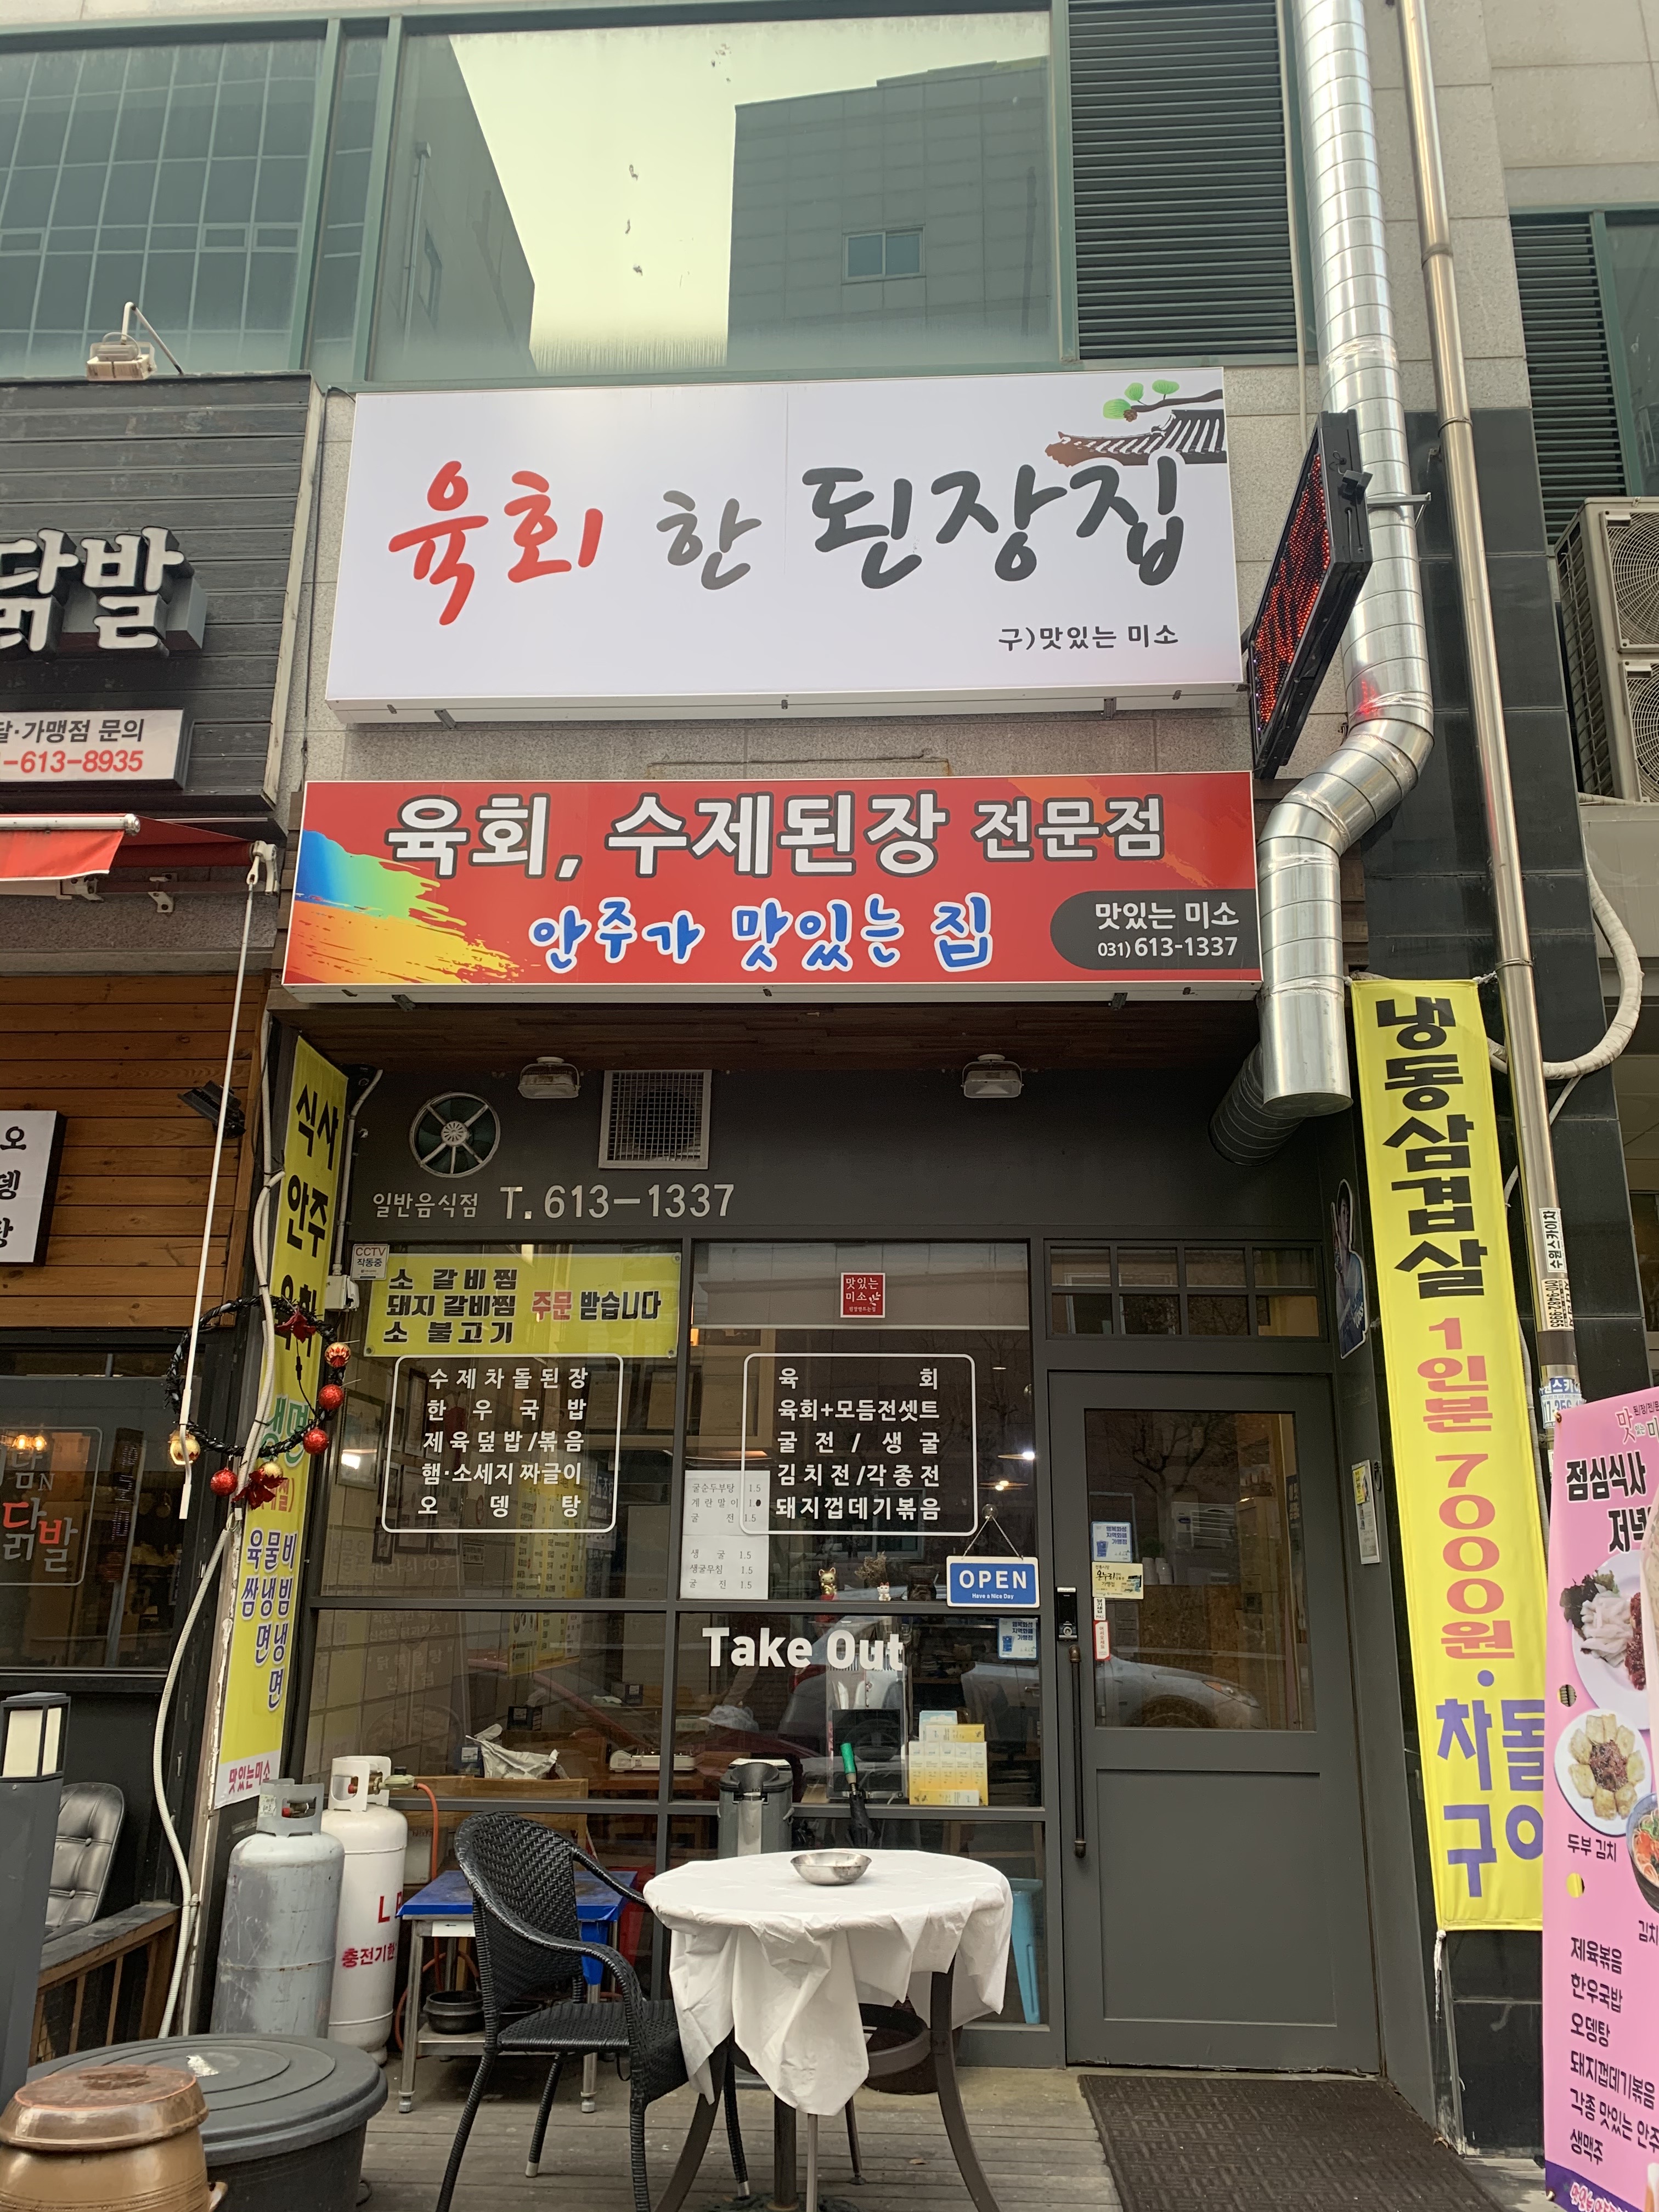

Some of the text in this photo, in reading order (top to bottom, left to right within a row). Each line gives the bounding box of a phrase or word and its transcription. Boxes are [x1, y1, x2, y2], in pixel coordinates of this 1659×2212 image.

[388, 460, 603, 626] 육회
[656, 489, 762, 591] 한
[802, 455, 1184, 590] 된장집
[998, 624, 1178, 652] 구)맛있는 미소
[99, 719, 144, 742] 문의
[385, 790, 1164, 881] 육회, 수제된장 전문점
[1094, 901, 1239, 930] 맛있는 미소
[529, 893, 992, 973] 안주가 맛있는 집
[1098, 936, 1238, 958] 031) 613-1337
[297, 1084, 338, 1170] 식사
[1375, 996, 1488, 1299] 냉동삼겹살
[287, 1175, 328, 1257] 안주
[373, 1192, 478, 1218] 일반음식점
[545, 1183, 735, 1218] 613-1337
[356, 1247, 386, 1256] CCTV
[1542, 1210, 1564, 1269] 수원스카이차
[357, 1258, 382, 1267] 작동중
[389, 1268, 518, 1291] 소 갈비찜
[845, 1277, 878, 1290] 맛있는
[386, 1294, 516, 1318] 돼지 갈비찜
[532, 1290, 662, 1321] 주문 받습니다
[845, 1291, 867, 1302] 미소
[383, 1322, 513, 1344] 소 불고기
[1417, 1317, 1493, 1433] 1인분
[777, 1399, 940, 1422] 육회+모듬전셋트
[520, 1463, 581, 1485] 짜글이
[692, 1483, 761, 1493] 굴순두부탕 1.5
[1567, 1451, 1646, 1501] 점심식사
[744, 1514, 756, 1522] 1.5
[776, 1497, 940, 1521] 돼지껍데기볶음
[3, 1497, 78, 1572] 닭발
[690, 1564, 723, 1574] 생굴무침
[1435, 1454, 1515, 1659] 7000원
[959, 1570, 1026, 1589] OPEN
[1096, 1570, 1115, 1581] 온누리
[256, 1531, 280, 1664] 물냉면
[269, 1532, 297, 1709] 비빔냉면
[702, 1627, 904, 1672] Take Out
[1435, 1699, 1545, 1791] 차돌
[1567, 1833, 1616, 1862] 두부 김치
[1639, 1920, 1658, 1946] 김치
[341, 1943, 395, 1968] 충전기한
[1571, 1937, 1622, 1974] 제육볶음
[1571, 1973, 1623, 2013] 한우국밥
[1571, 2012, 1610, 2047] 오뎅탕
[1571, 2050, 1655, 2110] 돼지껍데기볶음
[1570, 2088, 1659, 2153] 각종 맛있는 안주
[1570, 2129, 1604, 2165] 생맥주
